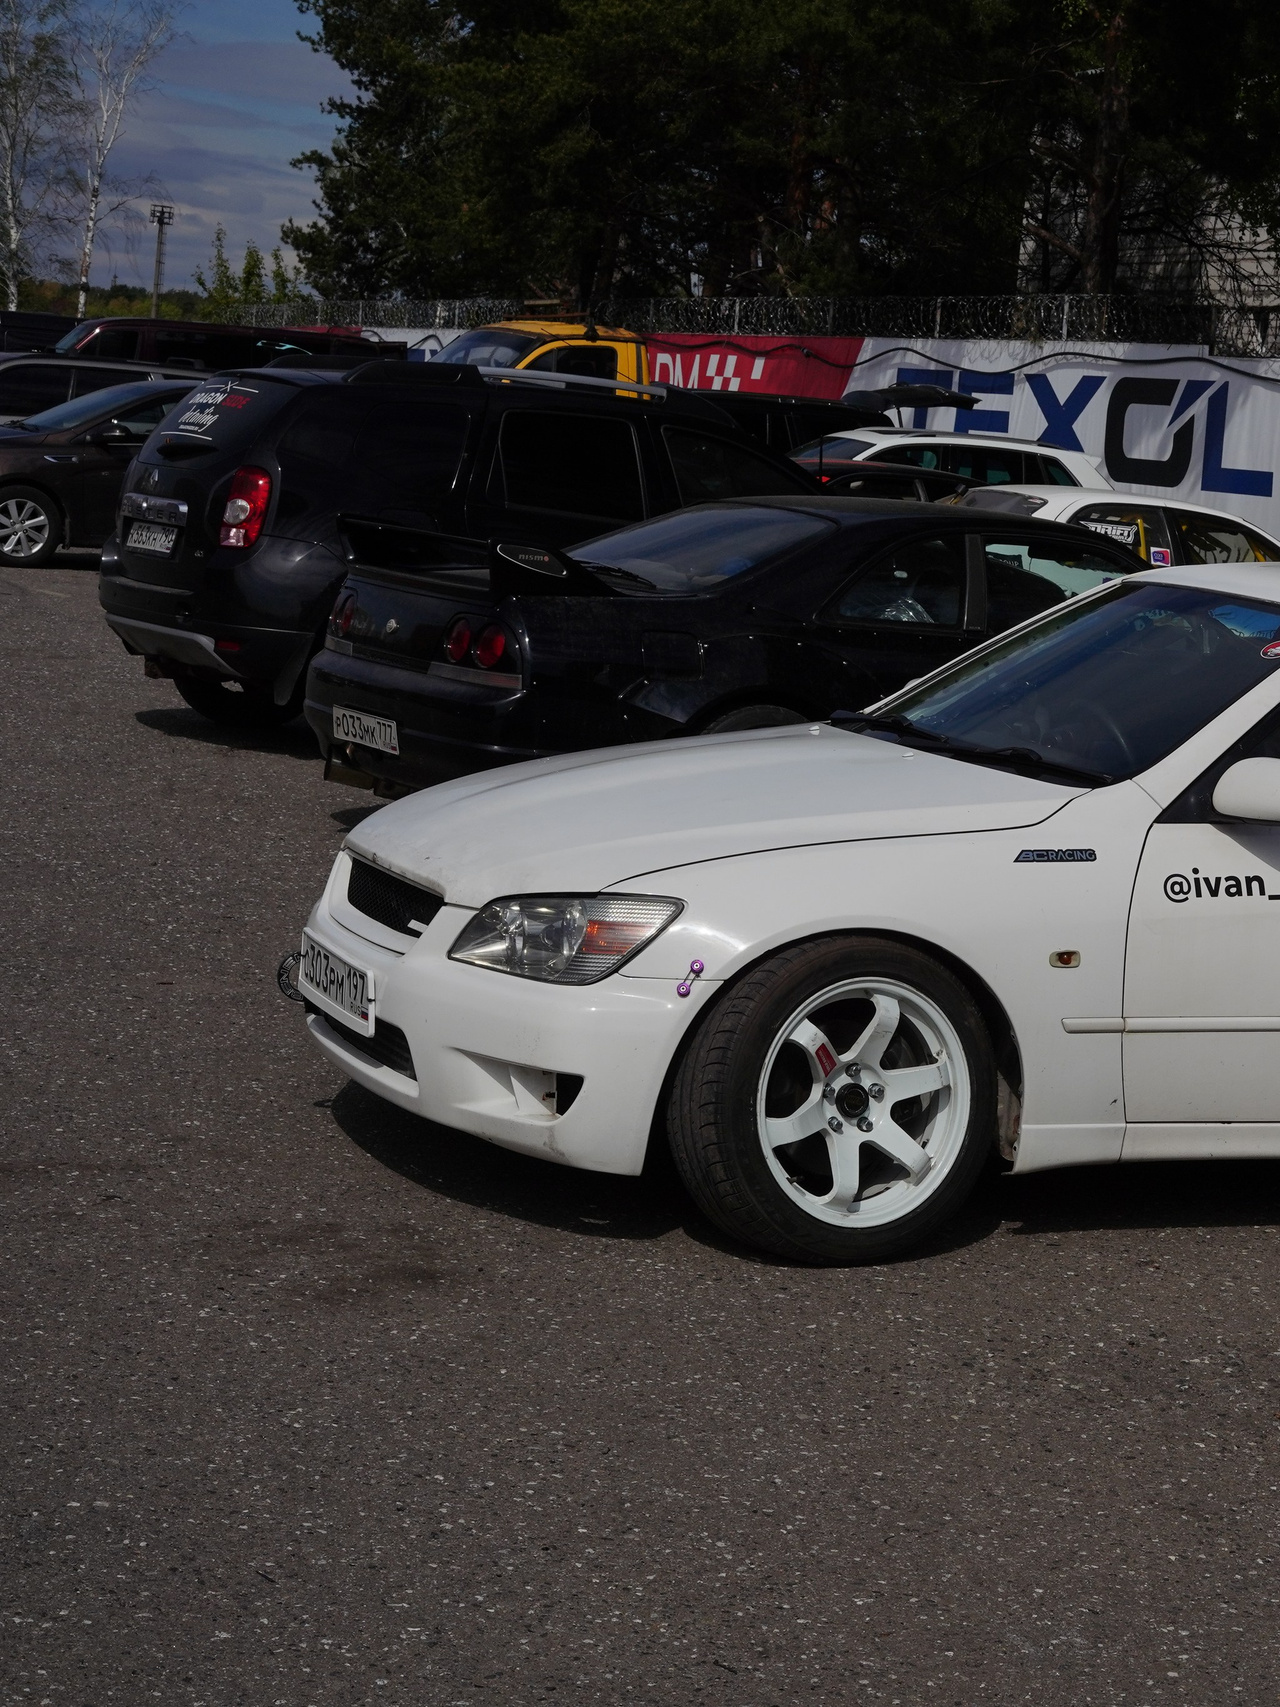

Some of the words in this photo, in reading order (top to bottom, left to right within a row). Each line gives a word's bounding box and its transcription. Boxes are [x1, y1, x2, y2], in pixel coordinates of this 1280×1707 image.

[647, 353, 700, 389] DM
[188, 392, 228, 404] DRAGON
[221, 395, 251, 409] SIDE
